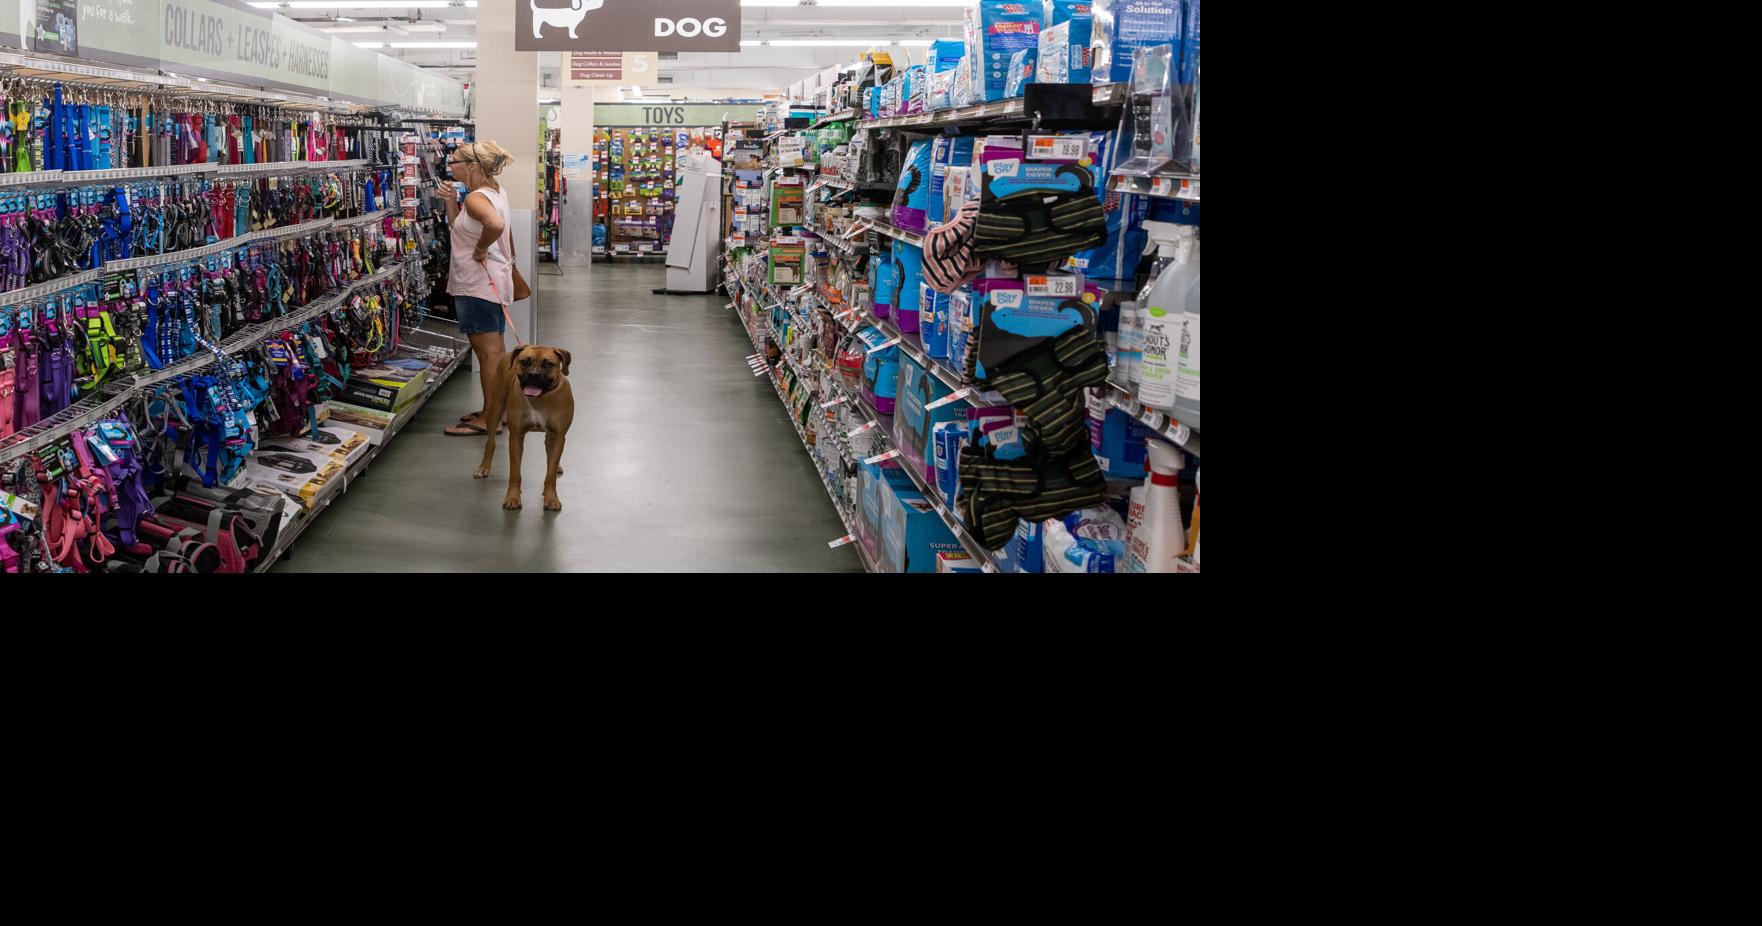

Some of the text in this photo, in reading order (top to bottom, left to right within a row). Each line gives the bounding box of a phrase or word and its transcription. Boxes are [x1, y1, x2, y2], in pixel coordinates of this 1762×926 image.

[82, 5, 95, 20] you
[96, 5, 107, 19] for
[1126, 5, 1172, 14] Solution
[654, 17, 727, 38] DOG
[164, 4, 224, 56] COLLARS
[238, 23, 280, 70] LEASHES
[289, 40, 329, 80] HARNESSES
[632, 54, 648, 73] 5
[642, 106, 684, 124] TOYS
[1055, 282, 1074, 294] 22.98
